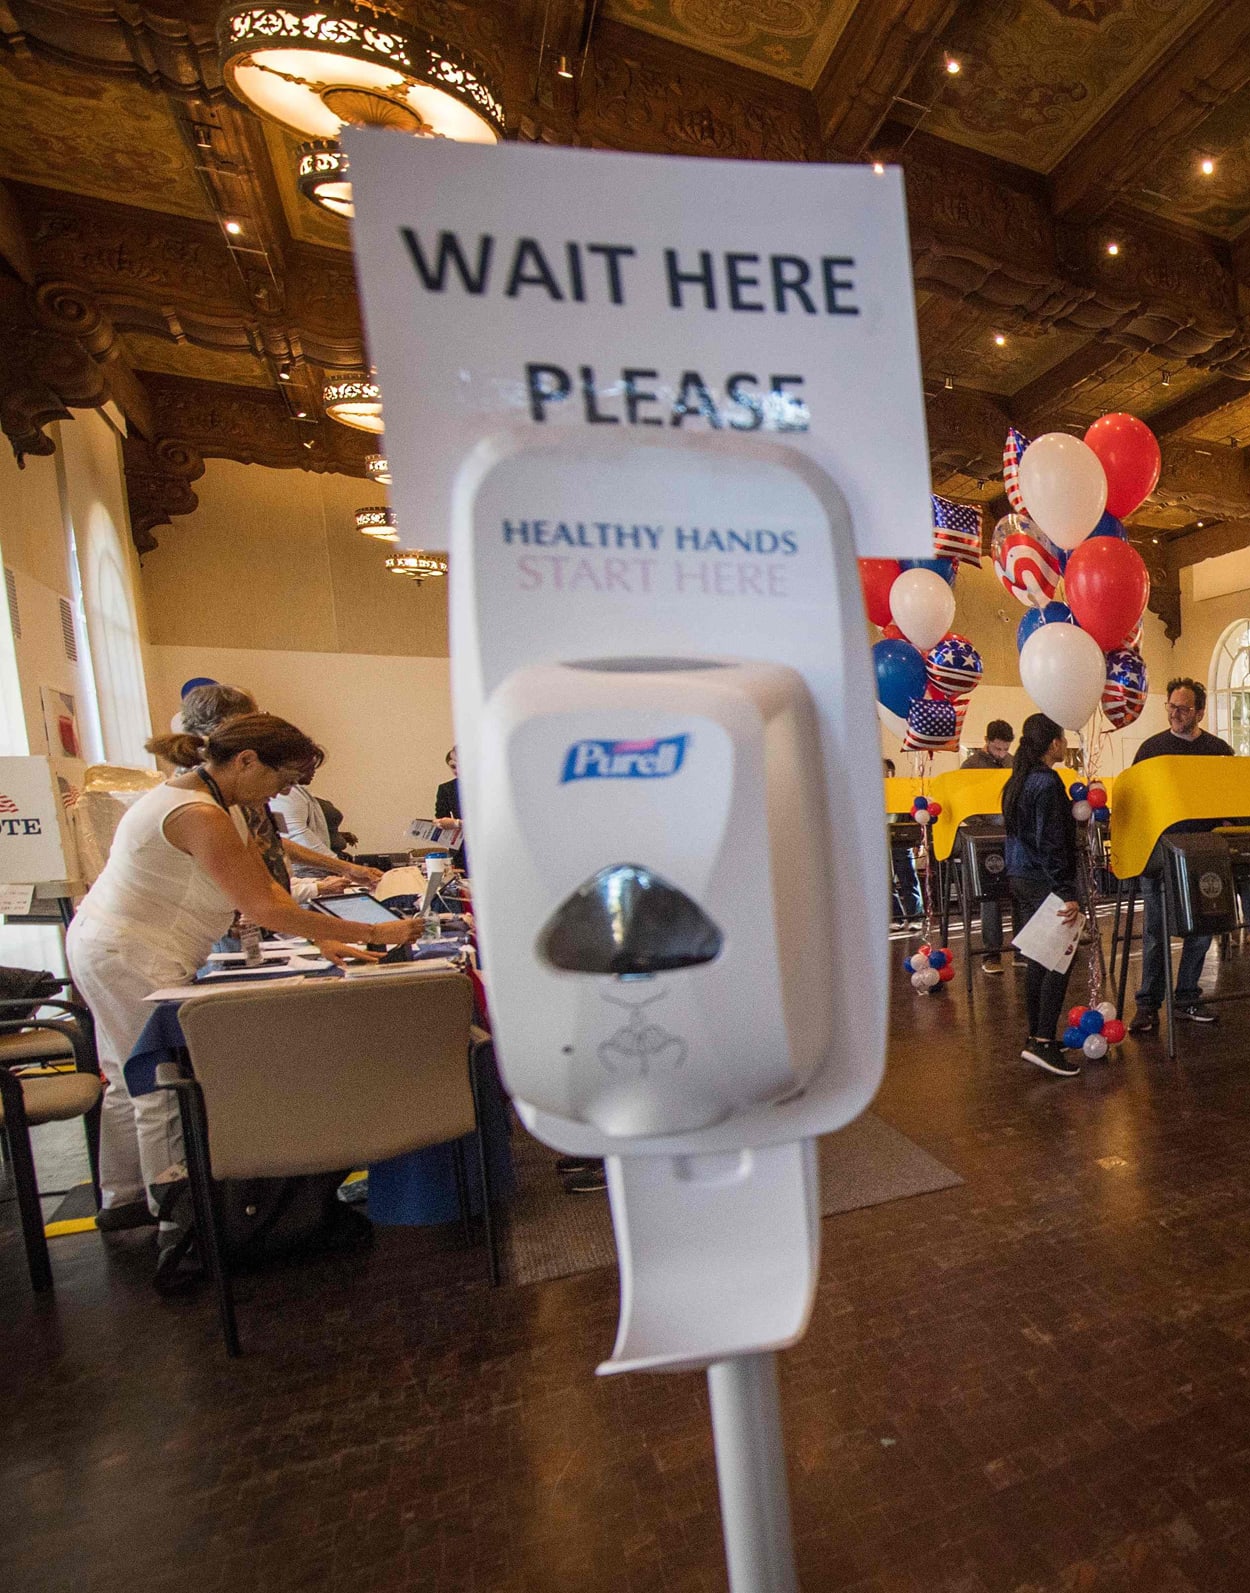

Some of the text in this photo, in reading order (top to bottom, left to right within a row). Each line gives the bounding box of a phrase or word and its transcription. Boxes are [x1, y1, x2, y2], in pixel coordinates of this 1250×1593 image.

[400, 226, 861, 316] WAIT HERE
[525, 362, 811, 433] PLEASE
[502, 519, 798, 555] HEALTHY HANDS
[518, 553, 789, 597] START HERE
